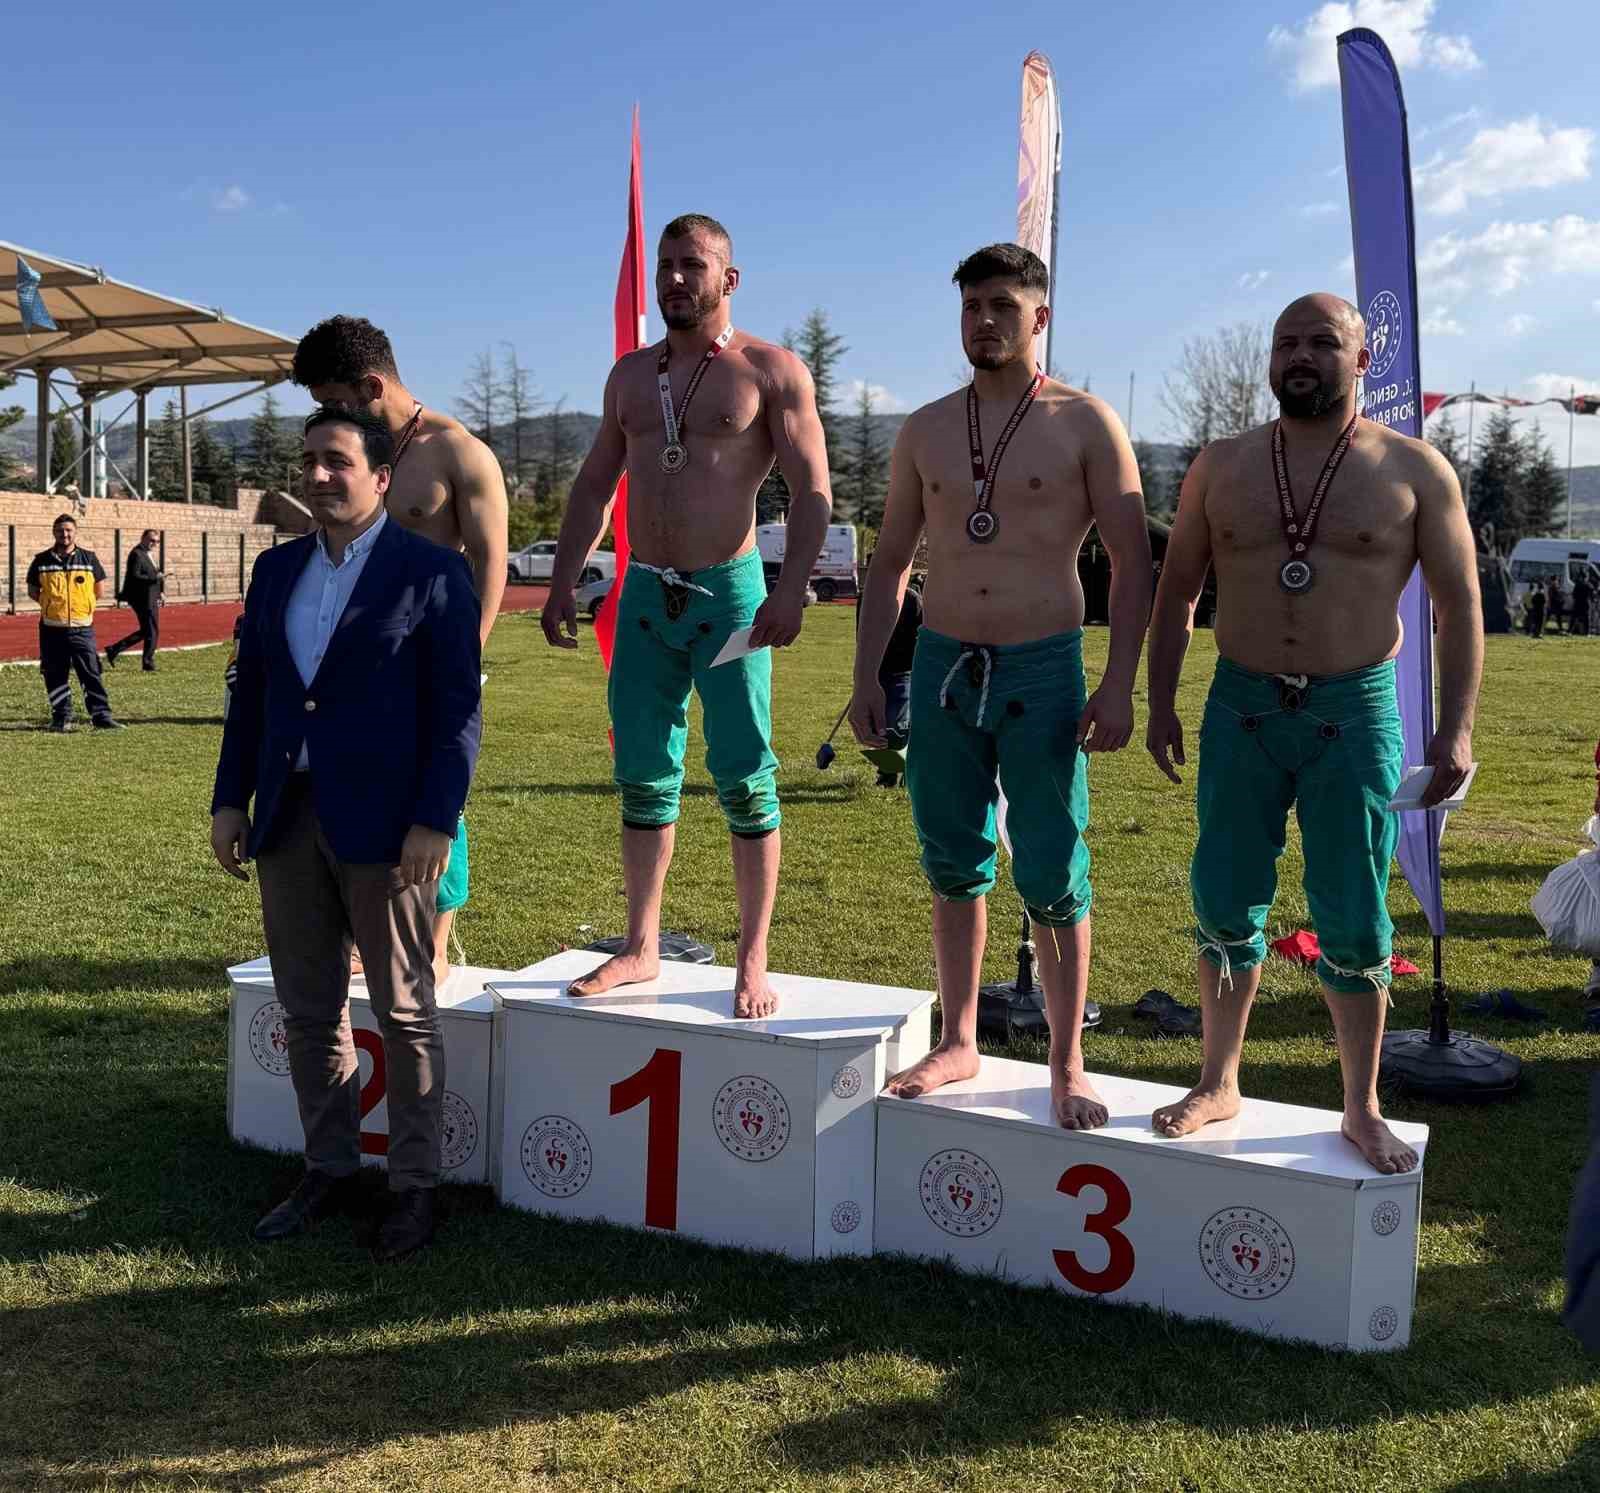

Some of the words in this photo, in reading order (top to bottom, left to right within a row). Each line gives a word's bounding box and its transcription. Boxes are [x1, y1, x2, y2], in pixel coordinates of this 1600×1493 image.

[352, 1028, 389, 1156] 2
[609, 1048, 682, 1232] 1
[1052, 1163, 1136, 1294] 3
